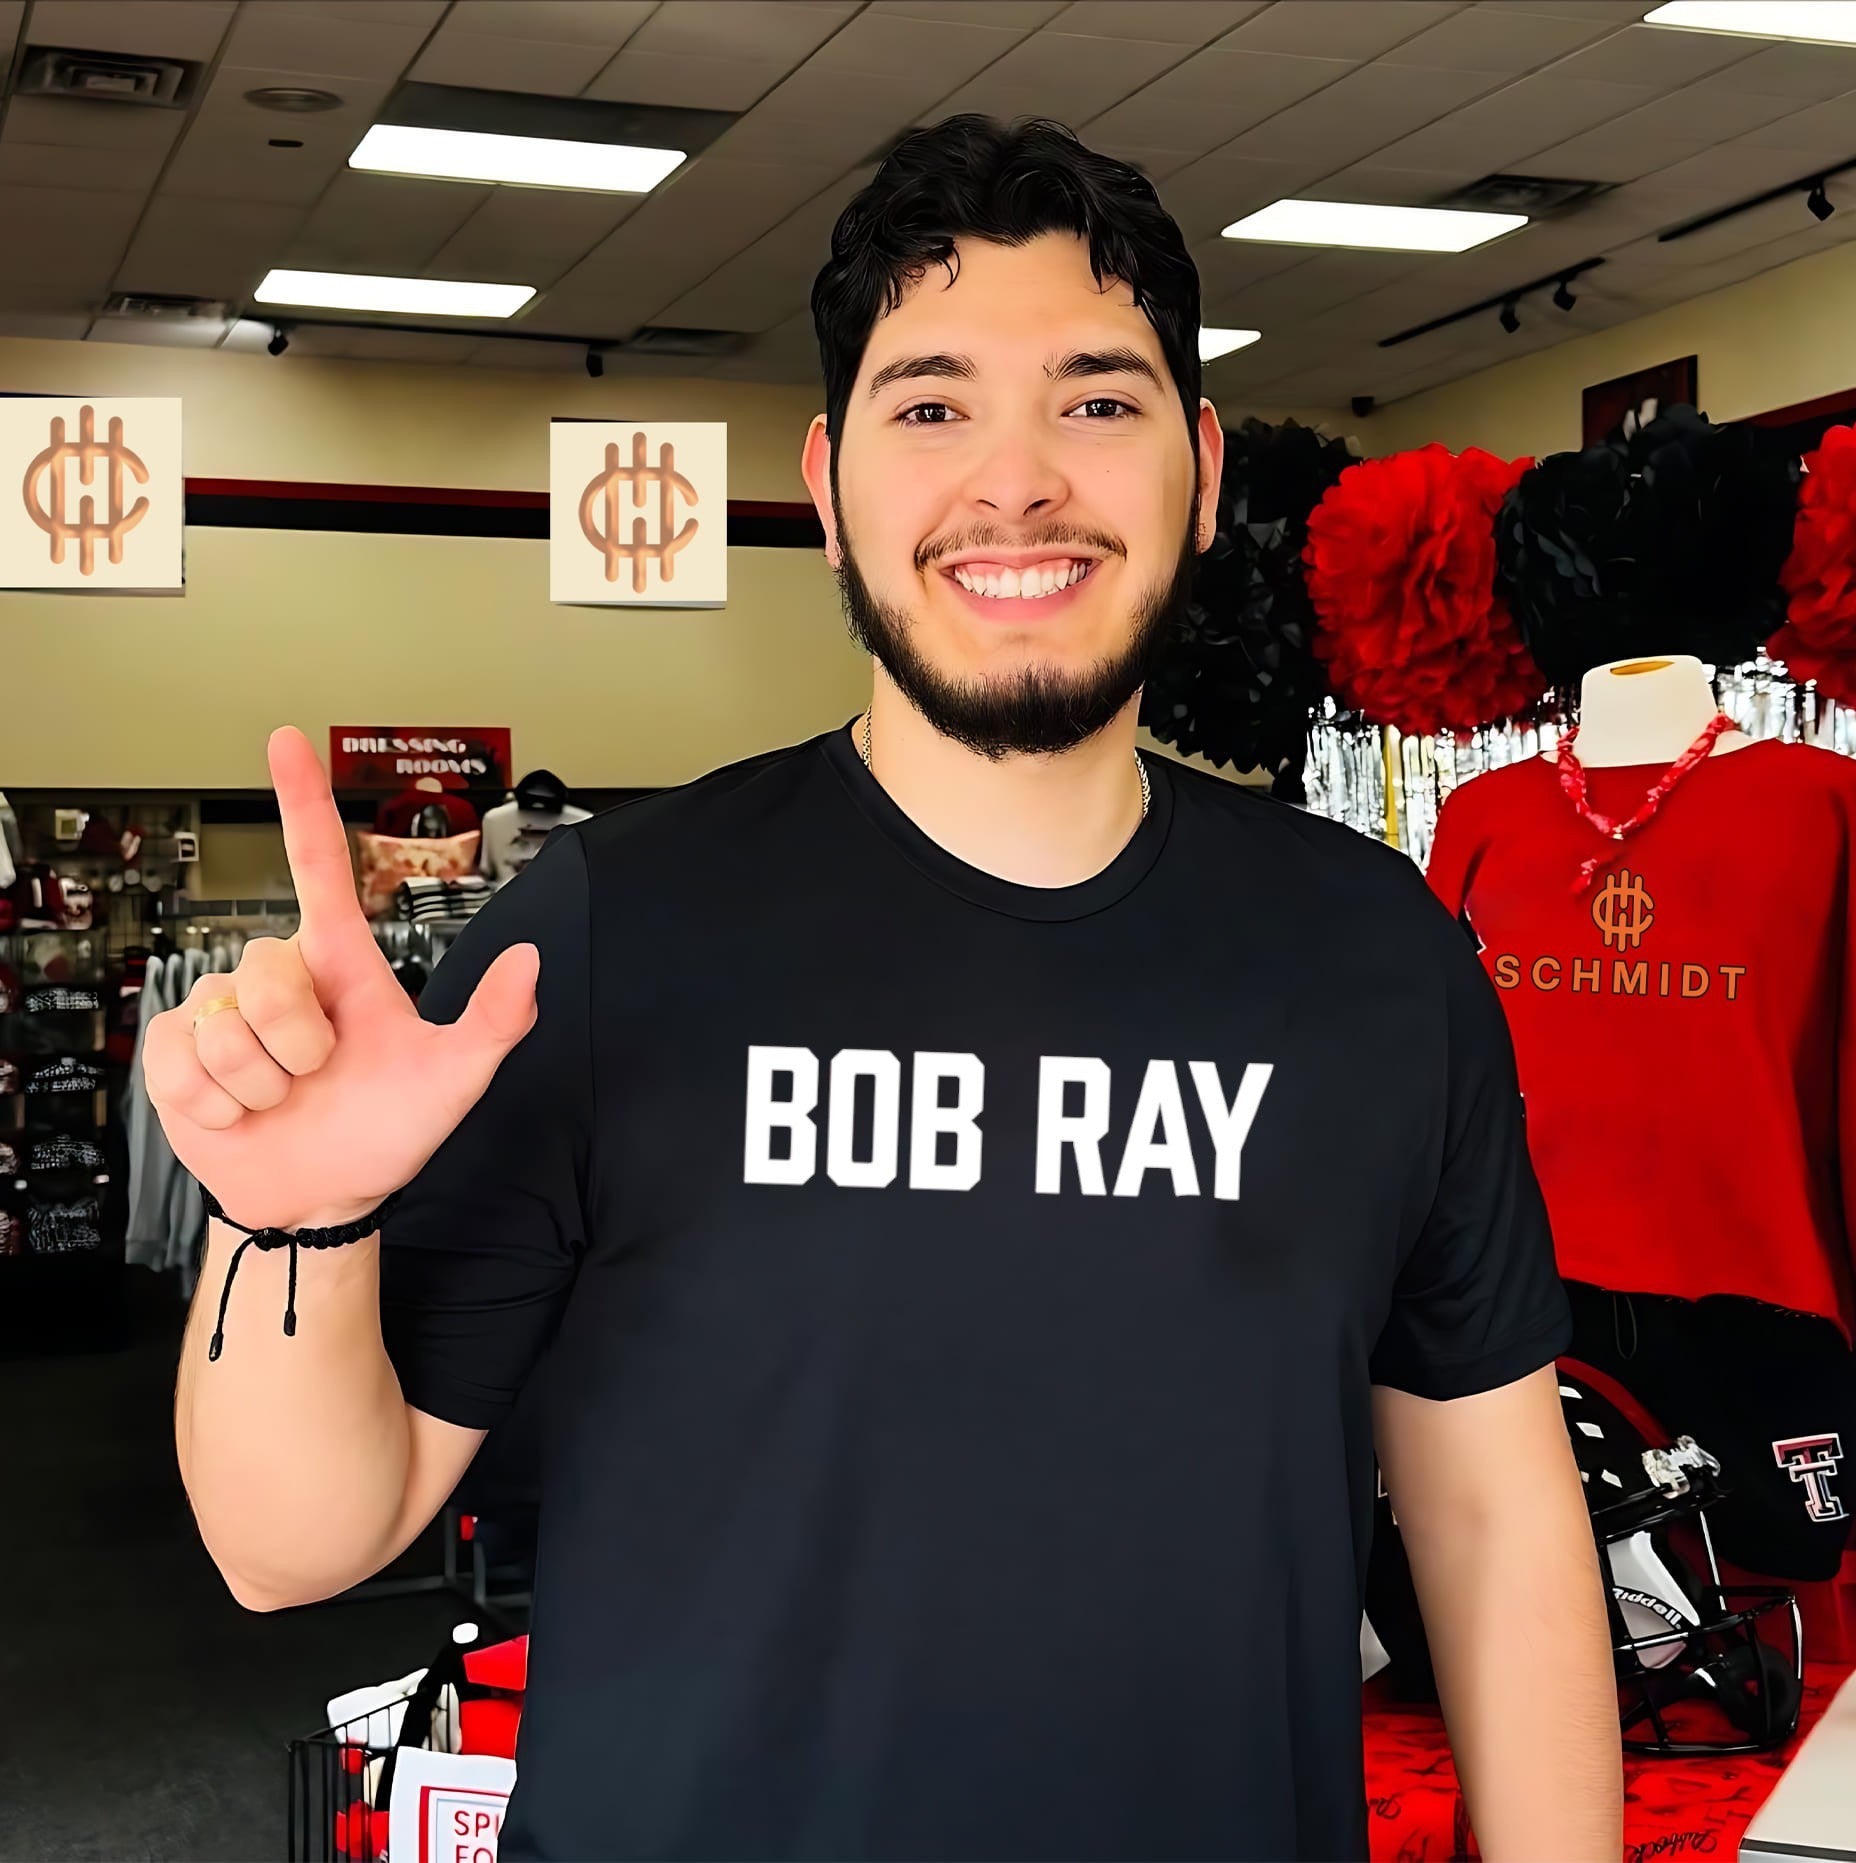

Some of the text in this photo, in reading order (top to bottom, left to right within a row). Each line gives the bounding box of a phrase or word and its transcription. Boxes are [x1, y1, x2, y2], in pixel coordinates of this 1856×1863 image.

[396, 758, 487, 775] ROOMS
[1494, 953, 1747, 1000] SCHMIDT
[743, 1045, 1275, 1201] BOB RAY
